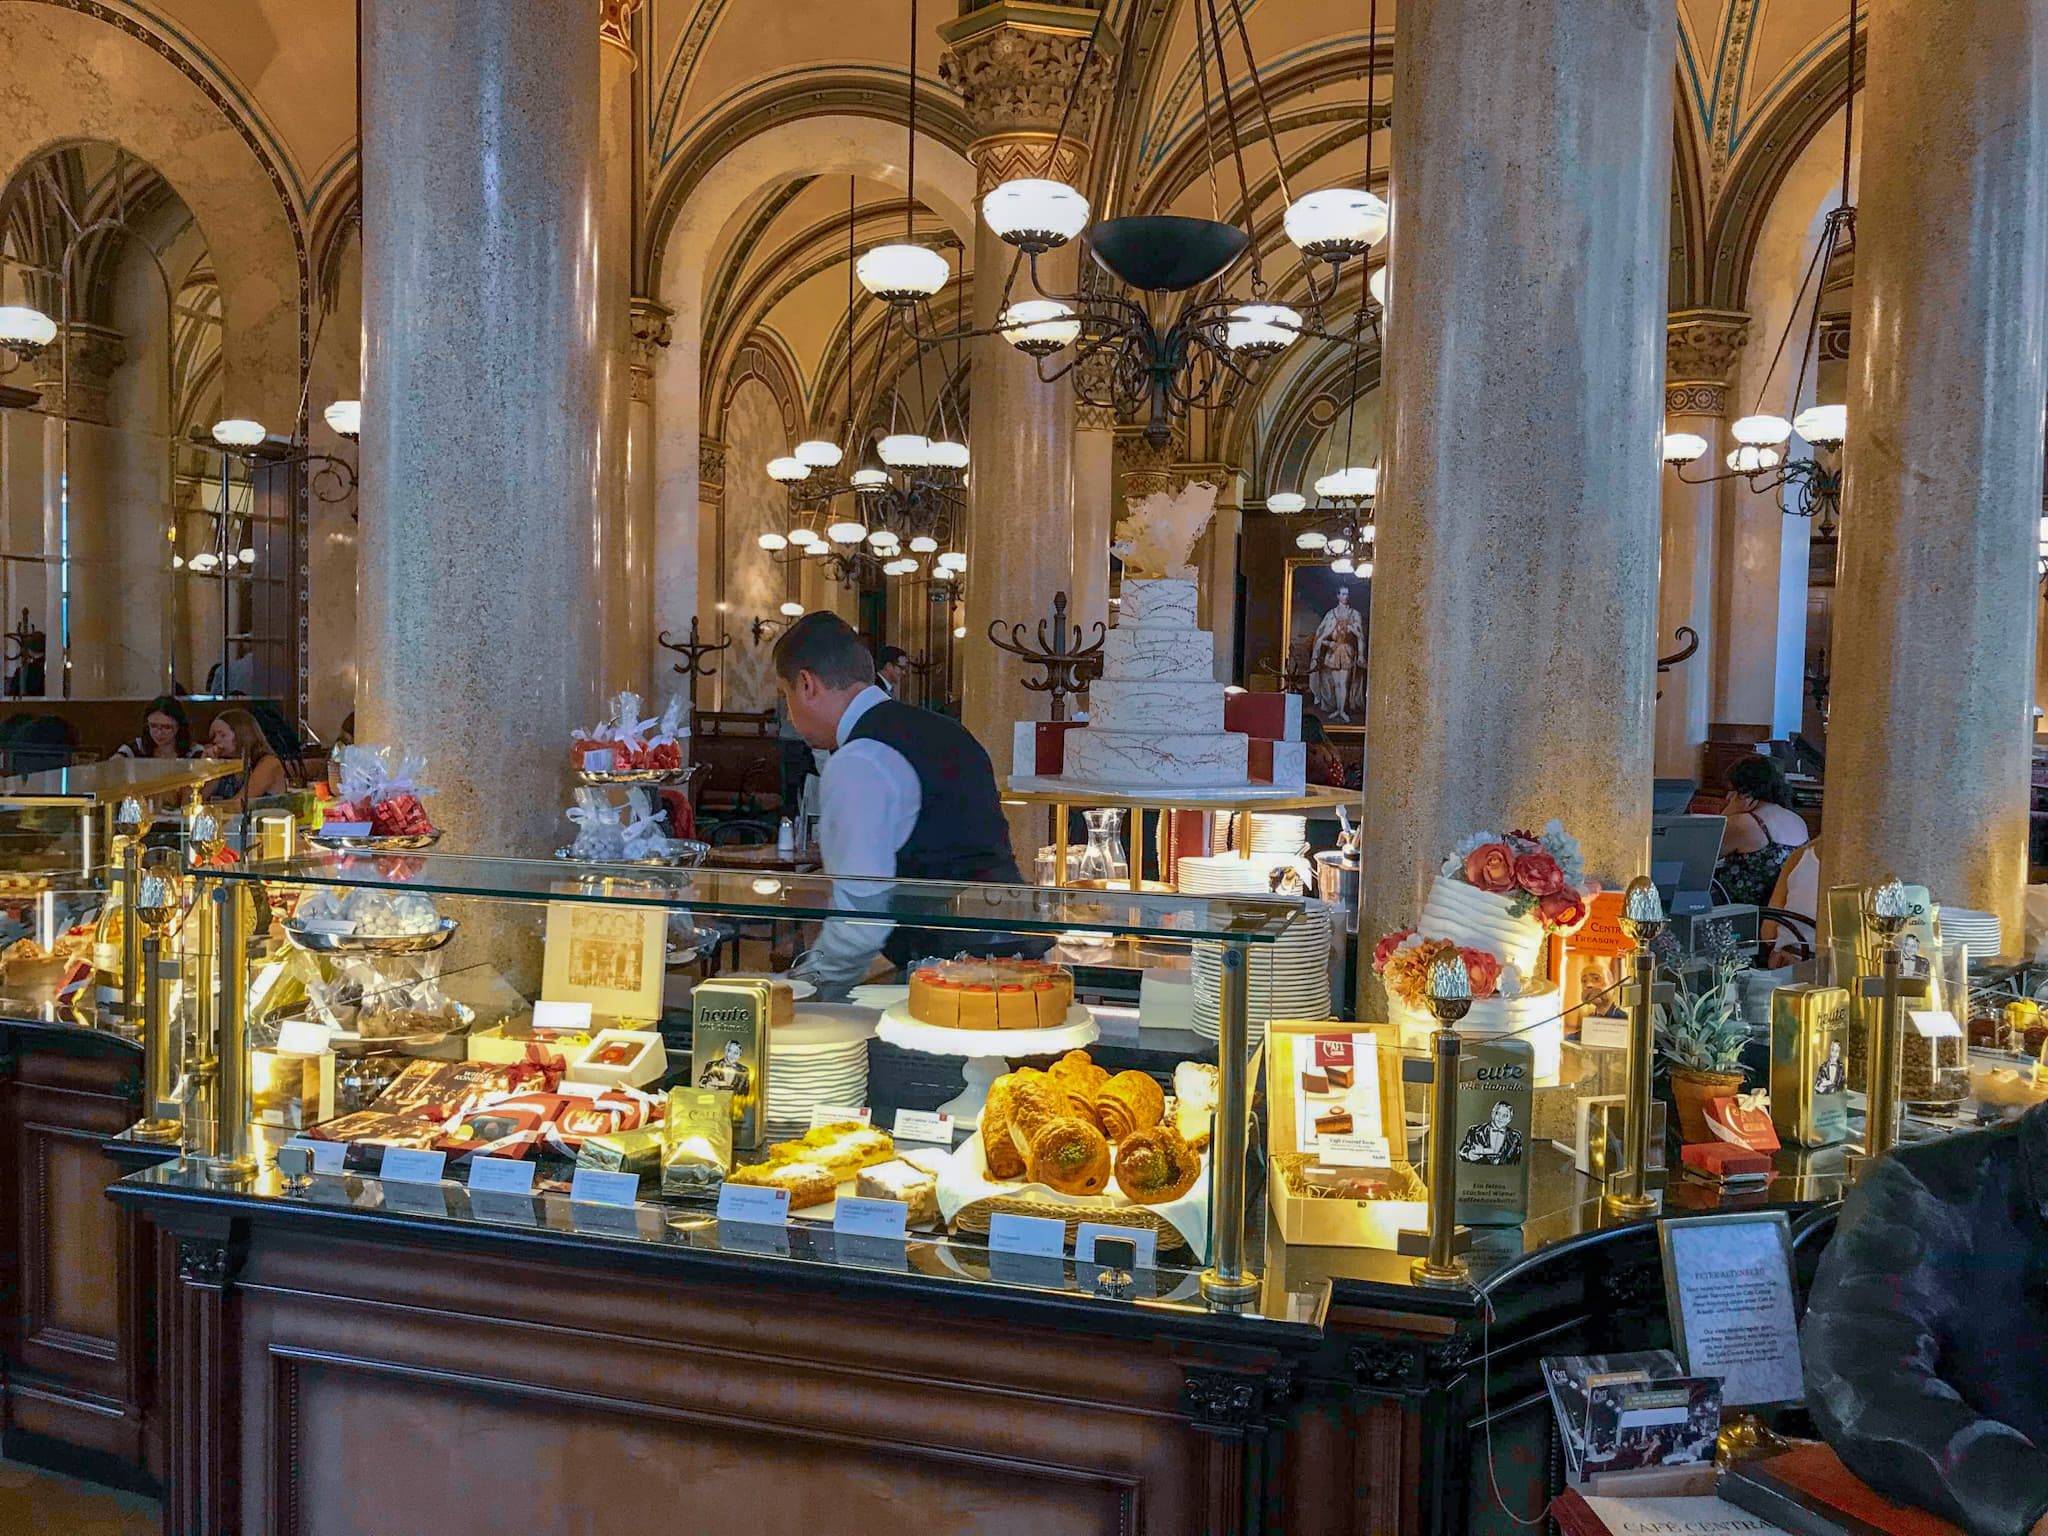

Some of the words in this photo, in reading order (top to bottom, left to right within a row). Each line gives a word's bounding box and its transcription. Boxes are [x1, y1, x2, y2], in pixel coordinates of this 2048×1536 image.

[1590, 921, 1622, 935] CENTR
[700, 1006, 751, 1022] heute
[1476, 1063, 1527, 1081] eute
[1684, 1520, 1776, 1533] CENTRA
